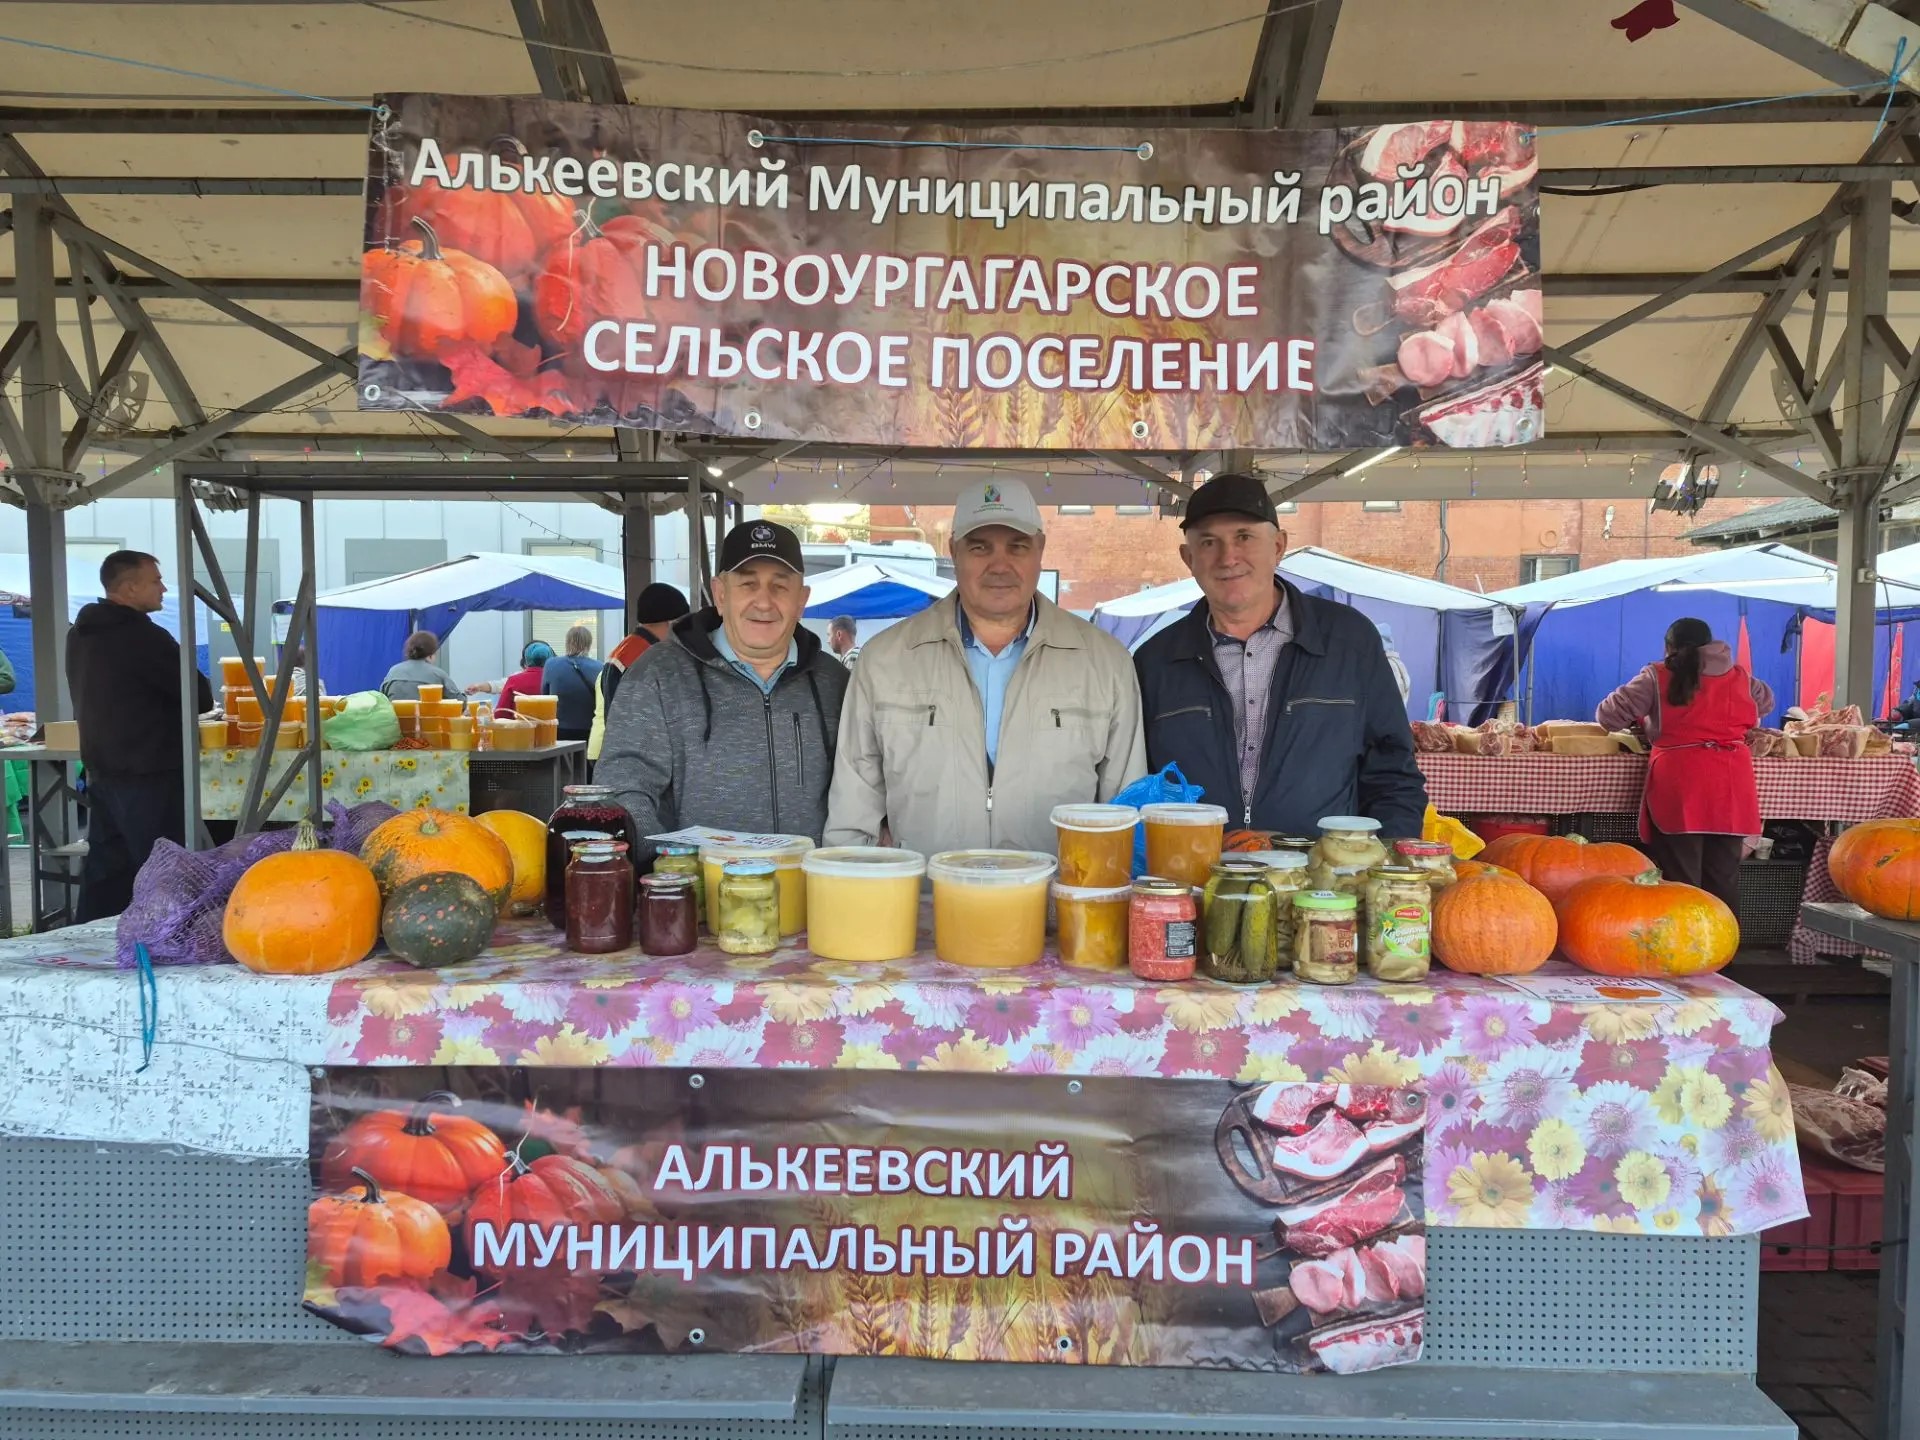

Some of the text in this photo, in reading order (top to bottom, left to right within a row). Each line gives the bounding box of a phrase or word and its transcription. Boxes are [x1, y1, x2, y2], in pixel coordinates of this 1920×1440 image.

[410, 137, 1501, 234] Алькеевский Муниципальный район
[645, 244, 1259, 319] НОВОУРГАГАРСКОЕ
[583, 320, 1315, 392] СЕЛЬСКОЕ ПОСЕЛЕНИЕ
[653, 1144, 1071, 1197] АЛЬКЕЕВСКИЙ
[473, 1218, 1254, 1285] МУНИЦИПАЛЬНЫЙ РАЙОН
